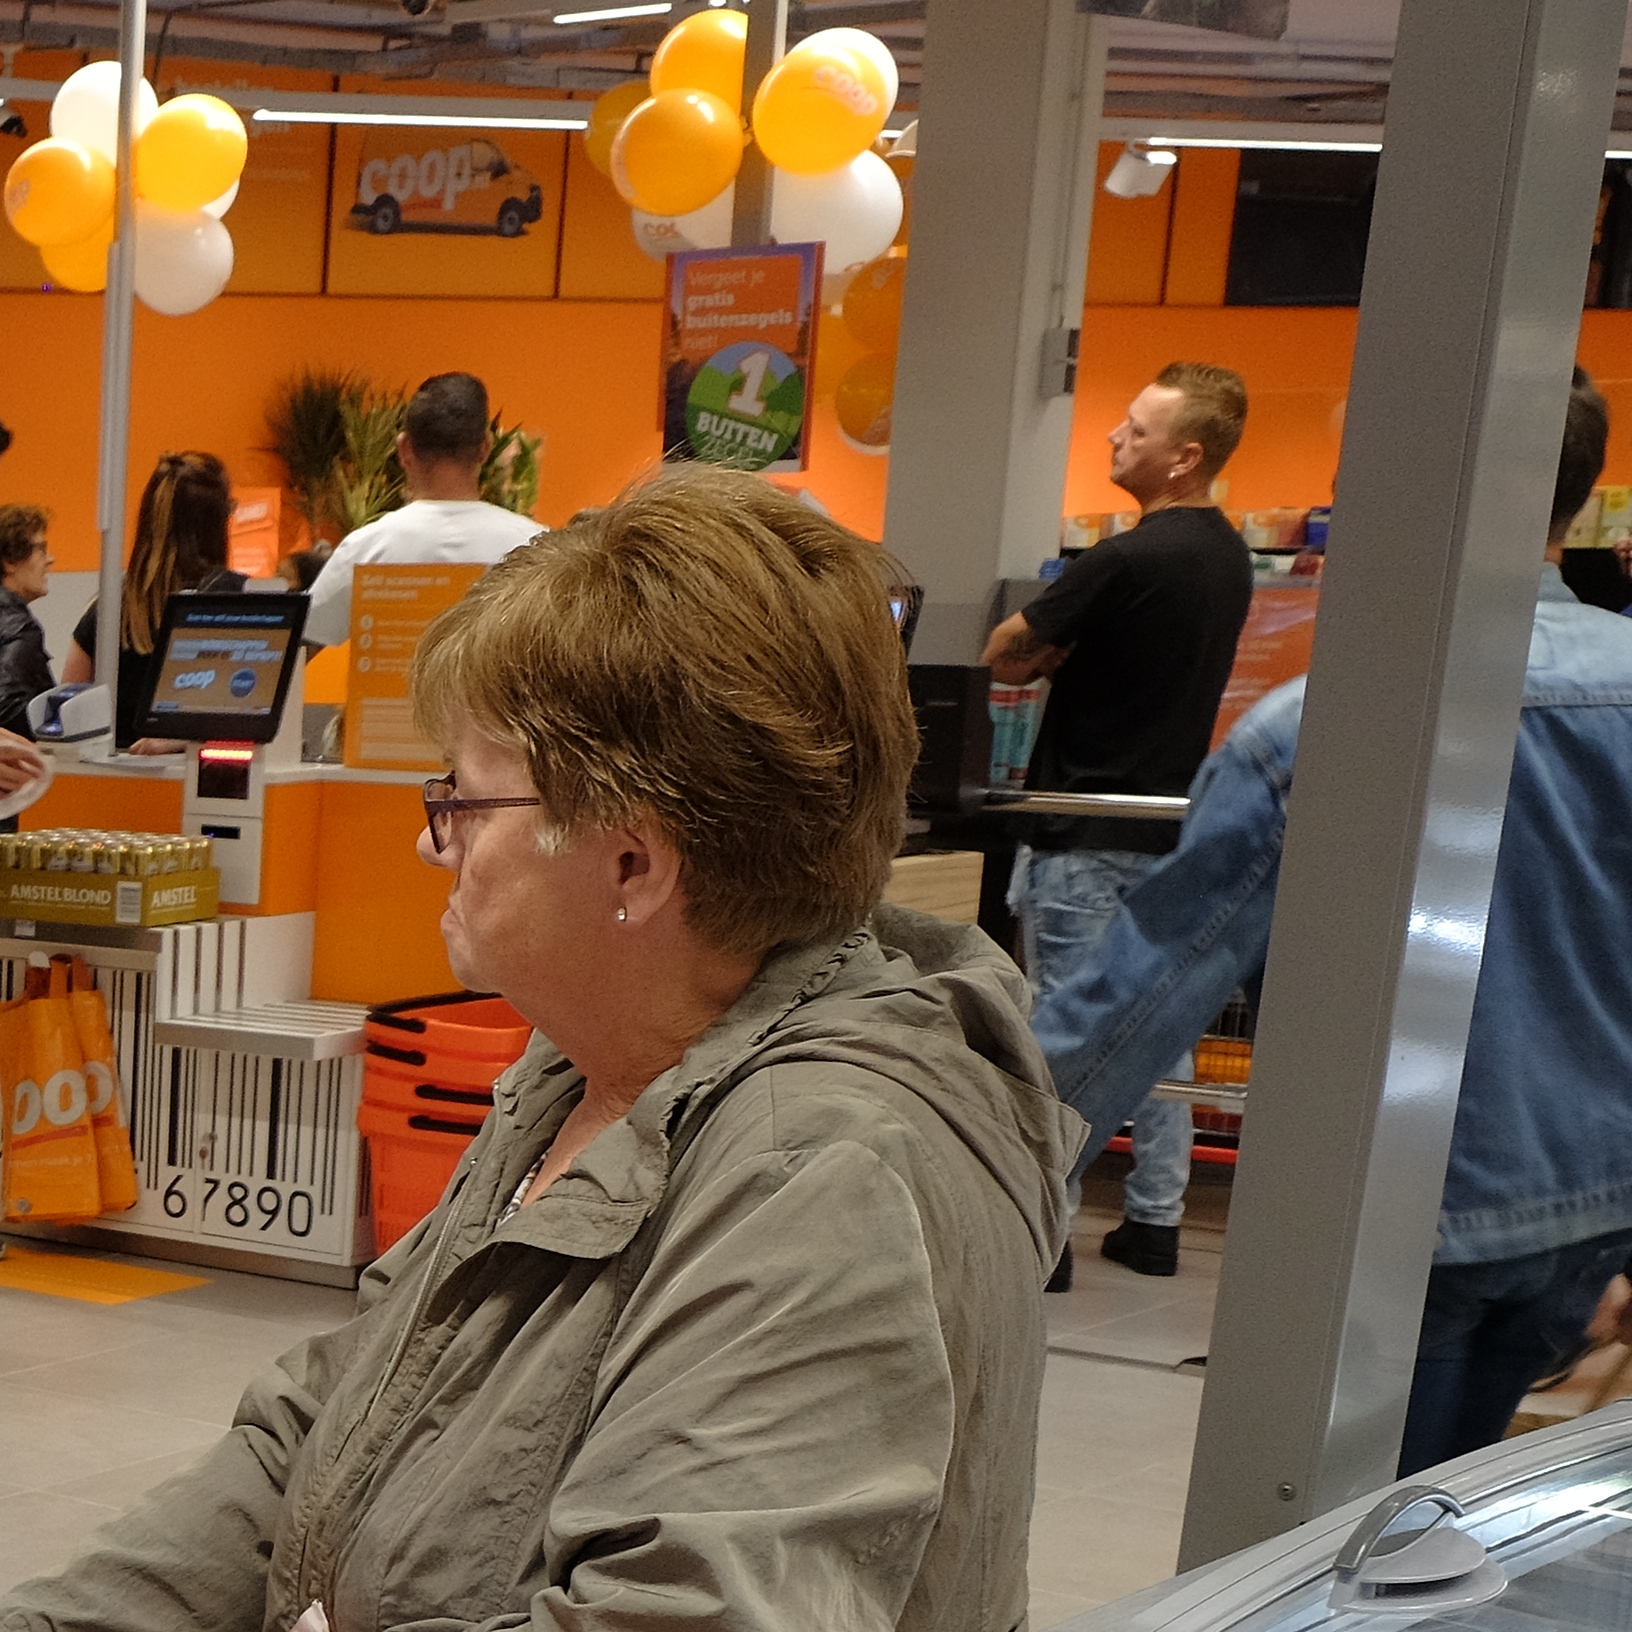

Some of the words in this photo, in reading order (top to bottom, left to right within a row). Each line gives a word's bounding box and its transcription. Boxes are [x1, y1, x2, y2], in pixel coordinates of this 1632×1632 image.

[359, 144, 472, 211] coop
[728, 352, 772, 417] 1
[696, 411, 779, 452] BUITEN
[173, 669, 216, 690] coop
[10, 884, 62, 902] AMSTEL
[63, 887, 113, 905] BLOND
[151, 885, 198, 908] AMSTEL
[163, 1173, 314, 1238] 67890
